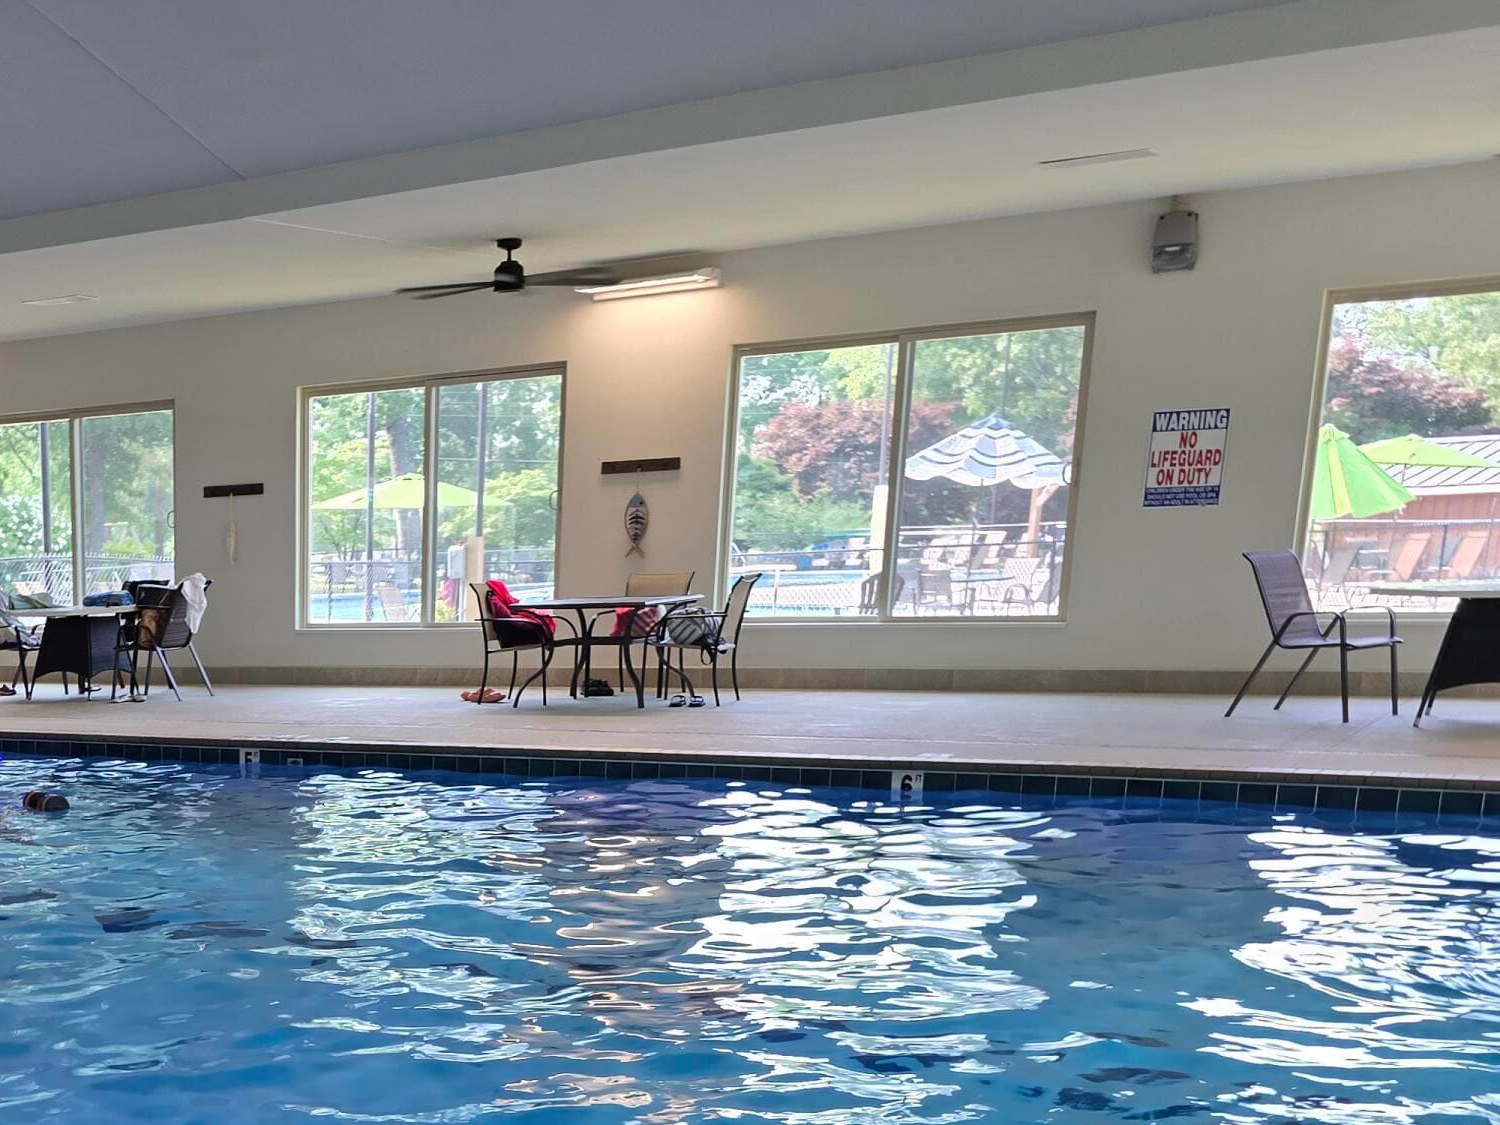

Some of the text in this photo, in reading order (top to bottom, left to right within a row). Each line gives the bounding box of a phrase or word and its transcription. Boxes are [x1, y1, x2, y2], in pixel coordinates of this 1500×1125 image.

[1155, 410, 1228, 431] WARNING
[1179, 431, 1198, 448] NO
[1150, 449, 1222, 468] LIFEGUARD
[1156, 467, 1212, 486] ON DUTY
[901, 774, 913, 791] 6
